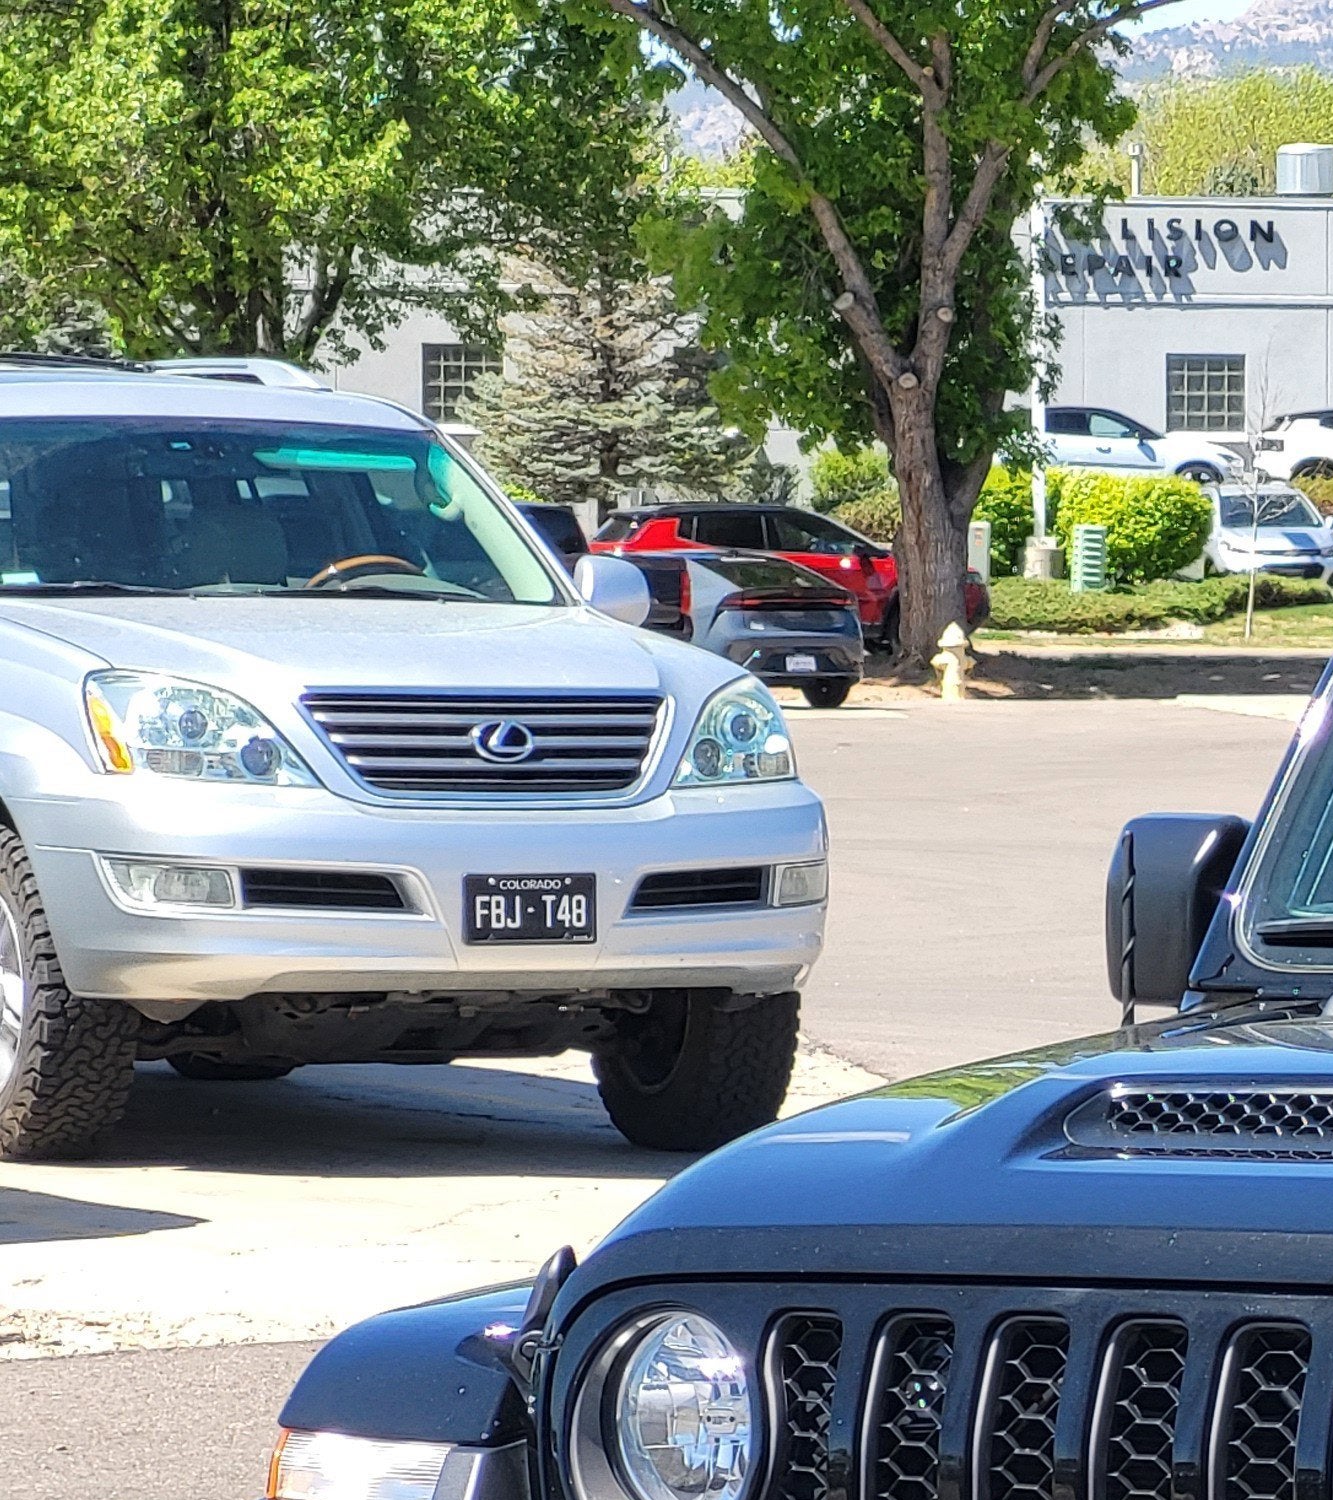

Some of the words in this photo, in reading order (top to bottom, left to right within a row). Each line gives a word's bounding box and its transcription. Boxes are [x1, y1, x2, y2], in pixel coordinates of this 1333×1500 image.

[1121, 217, 1274, 243] LISION
[1060, 254, 1182, 278] EPAIR
[500, 880, 561, 890] COLORADO
